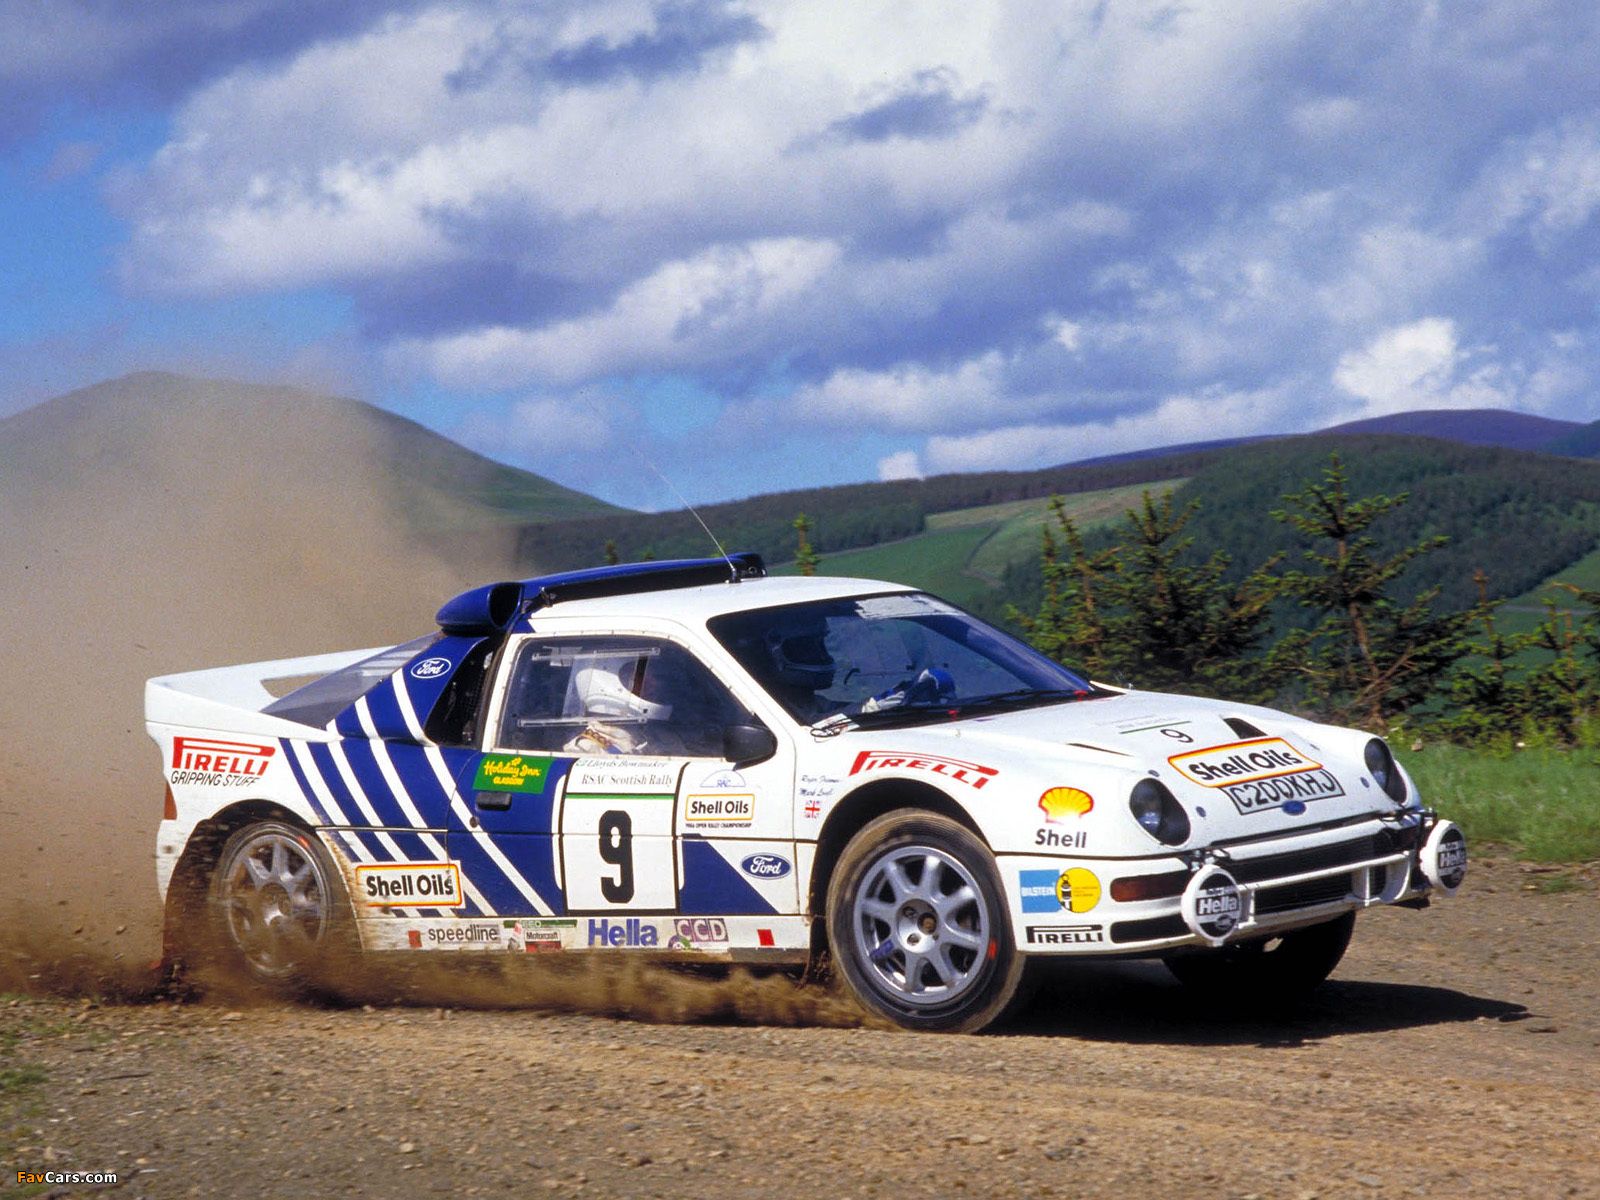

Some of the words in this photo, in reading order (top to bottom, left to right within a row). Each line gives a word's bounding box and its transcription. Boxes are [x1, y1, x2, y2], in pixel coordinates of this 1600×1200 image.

[417, 661, 444, 674] Ford
[1160, 729, 1193, 743] 9
[172, 736, 275, 776] PIRELLI
[1189, 755, 1251, 781] Shell
[1250, 749, 1303, 769] Oils
[171, 771, 222, 786] GRIPPING
[223, 774, 261, 786] STUFF
[484, 761, 520, 777] Holiday
[520, 764, 540, 776] Inn
[849, 751, 999, 789] PIRELLI
[582, 774, 606, 784] RSAC
[610, 773, 647, 784] Scottish
[649, 774, 672, 787] Rally
[691, 801, 722, 814] Shell
[725, 800, 749, 814] Oils
[1035, 828, 1087, 848] Shell
[599, 810, 634, 904] 9
[750, 856, 782, 874] Ford
[366, 874, 414, 897] Shell
[416, 874, 454, 896] Oils
[1198, 895, 1239, 915] Hella
[428, 924, 499, 942] speedline
[526, 932, 558, 940] Motorcraft
[588, 919, 657, 946] Hella
[675, 919, 728, 941] CCD
[1026, 924, 1103, 944] PIRELLI
